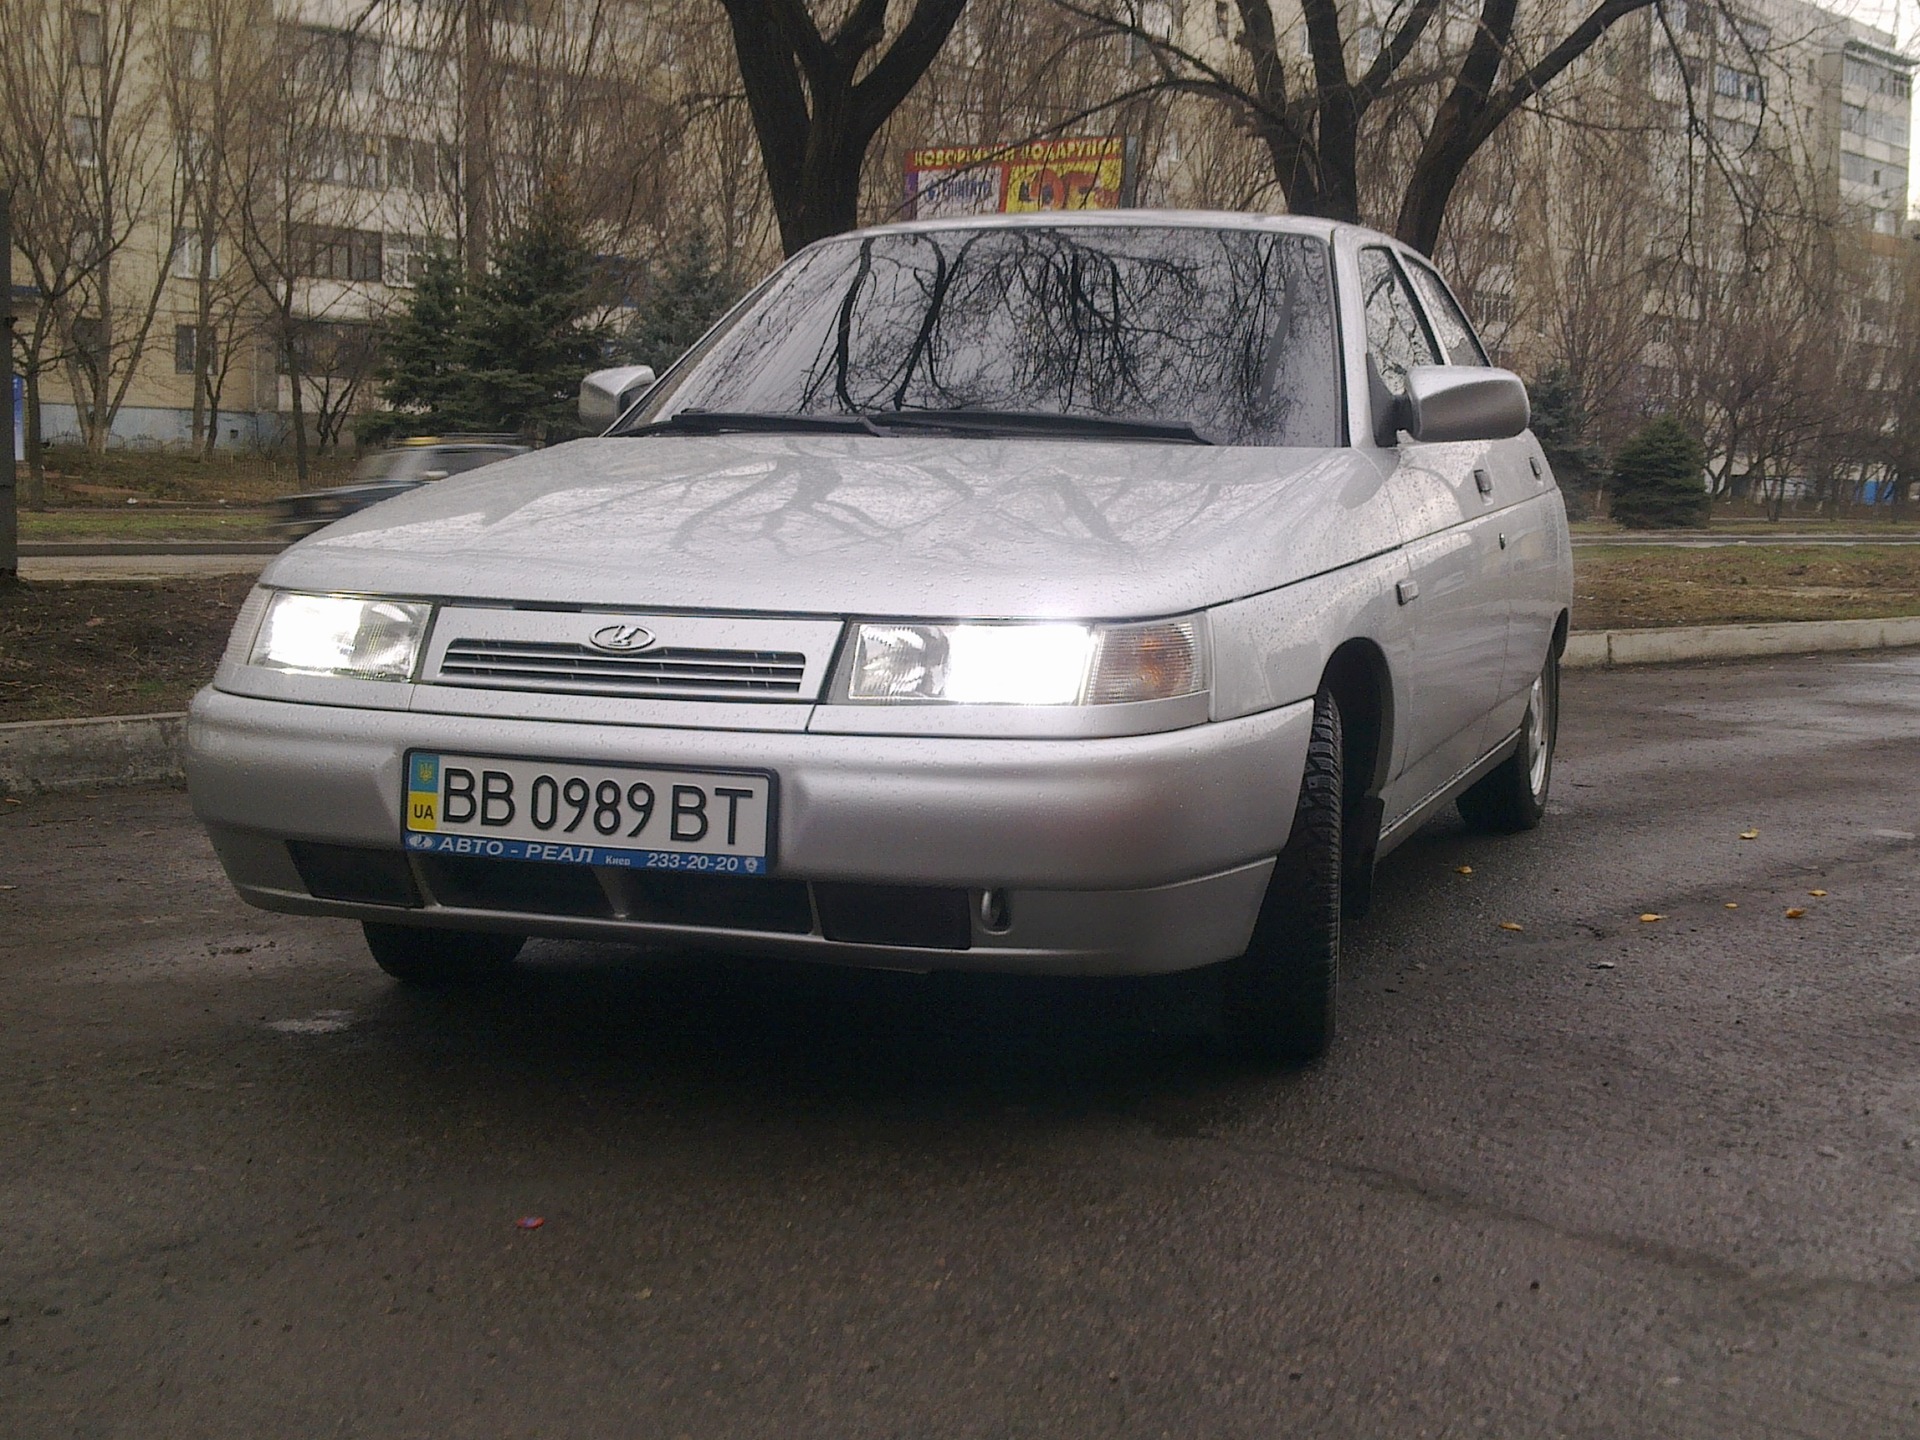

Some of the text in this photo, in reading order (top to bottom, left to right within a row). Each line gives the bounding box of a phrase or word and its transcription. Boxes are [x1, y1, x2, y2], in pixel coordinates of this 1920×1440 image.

[414, 804, 434, 820] UA
[443, 767, 754, 846] BB 0989 BT
[438, 834, 504, 856] АВТО
[525, 843, 595, 864] РЕАЛ
[605, 855, 631, 867] Киев
[646, 852, 739, 872] 233-20-20
